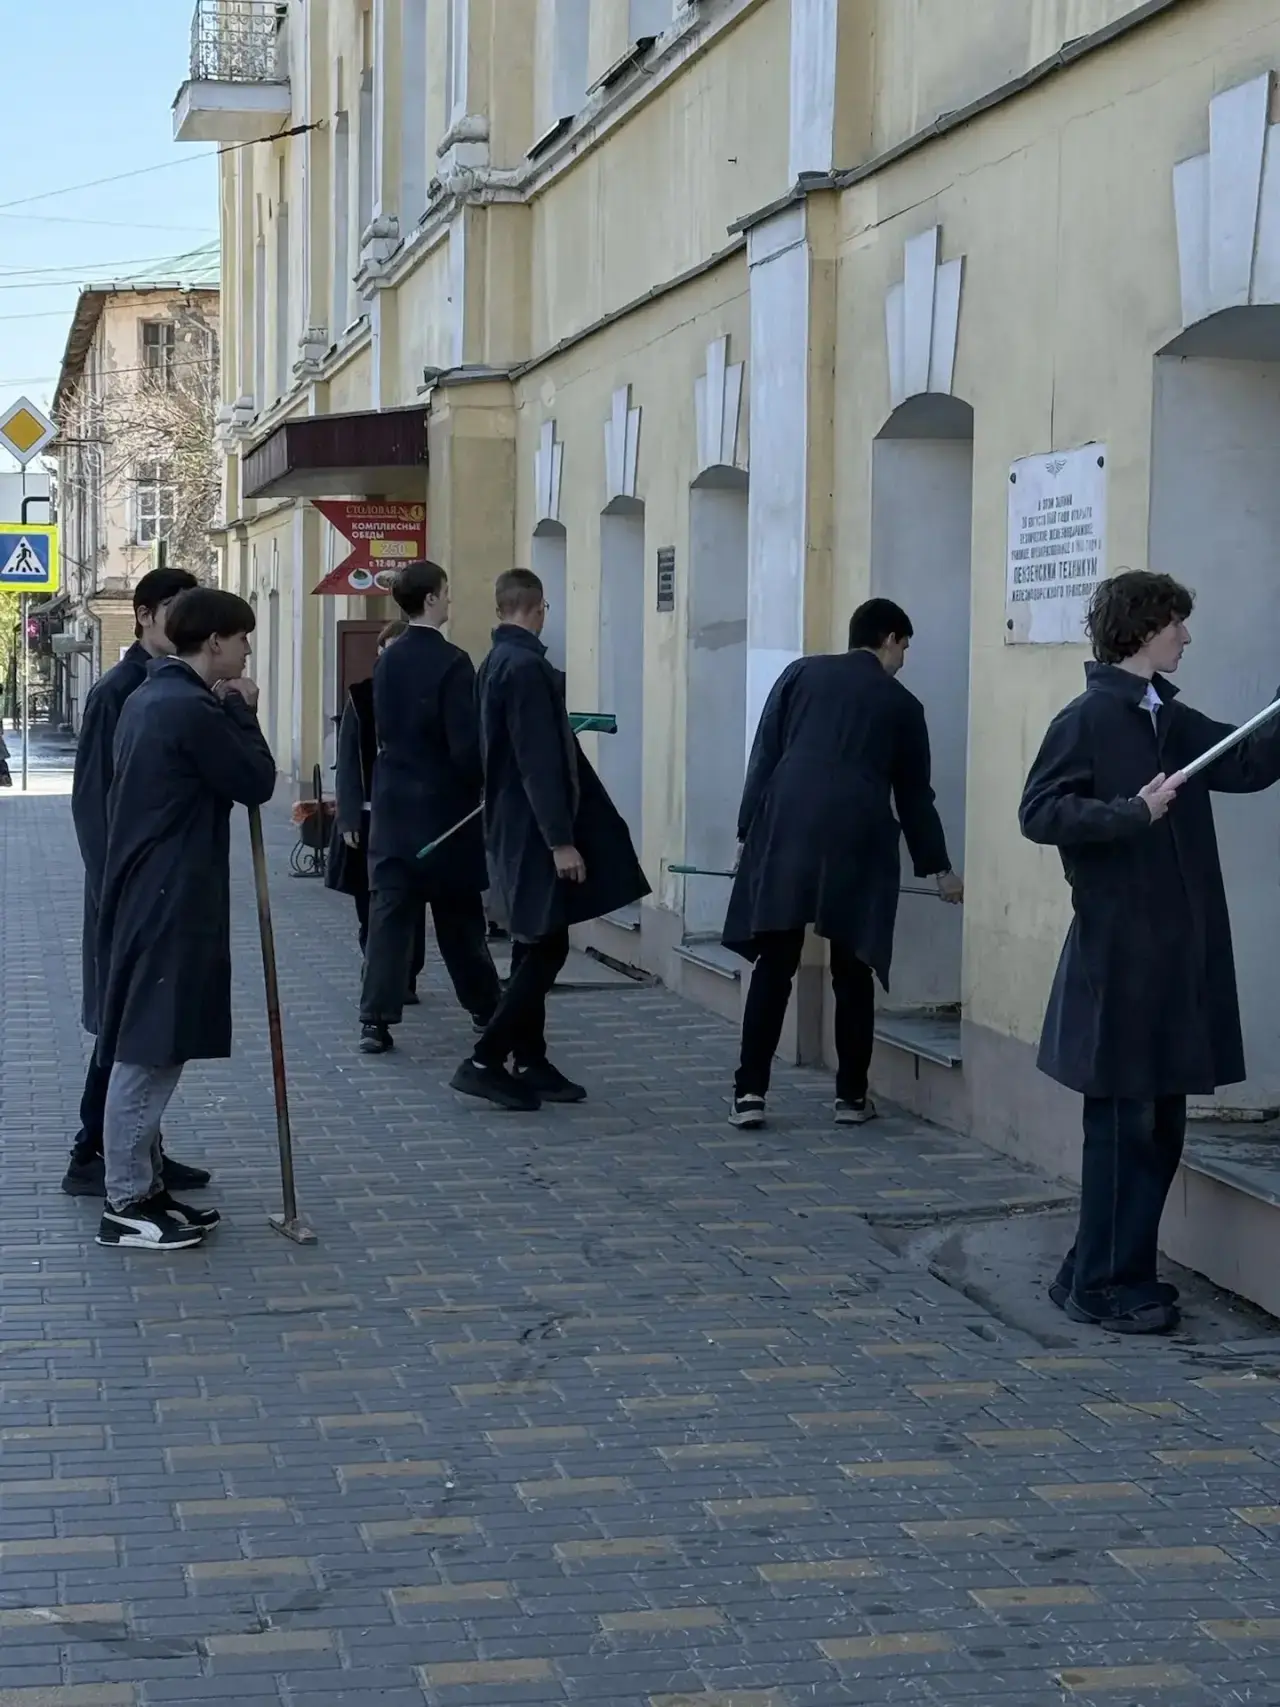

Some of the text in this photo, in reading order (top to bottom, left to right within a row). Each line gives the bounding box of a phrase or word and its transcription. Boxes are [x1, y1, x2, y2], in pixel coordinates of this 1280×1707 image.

[346, 505, 396, 515] СТОЛОВАЯ
[352, 522, 421, 531] КОМПЛЕКСНЫЕ
[352, 531, 385, 540] ОБЕДЫ
[381, 543, 406, 555] 250
[1013, 556, 1098, 584] ПЕНЗЕНСКИЙ ТЕХНИКУМ
